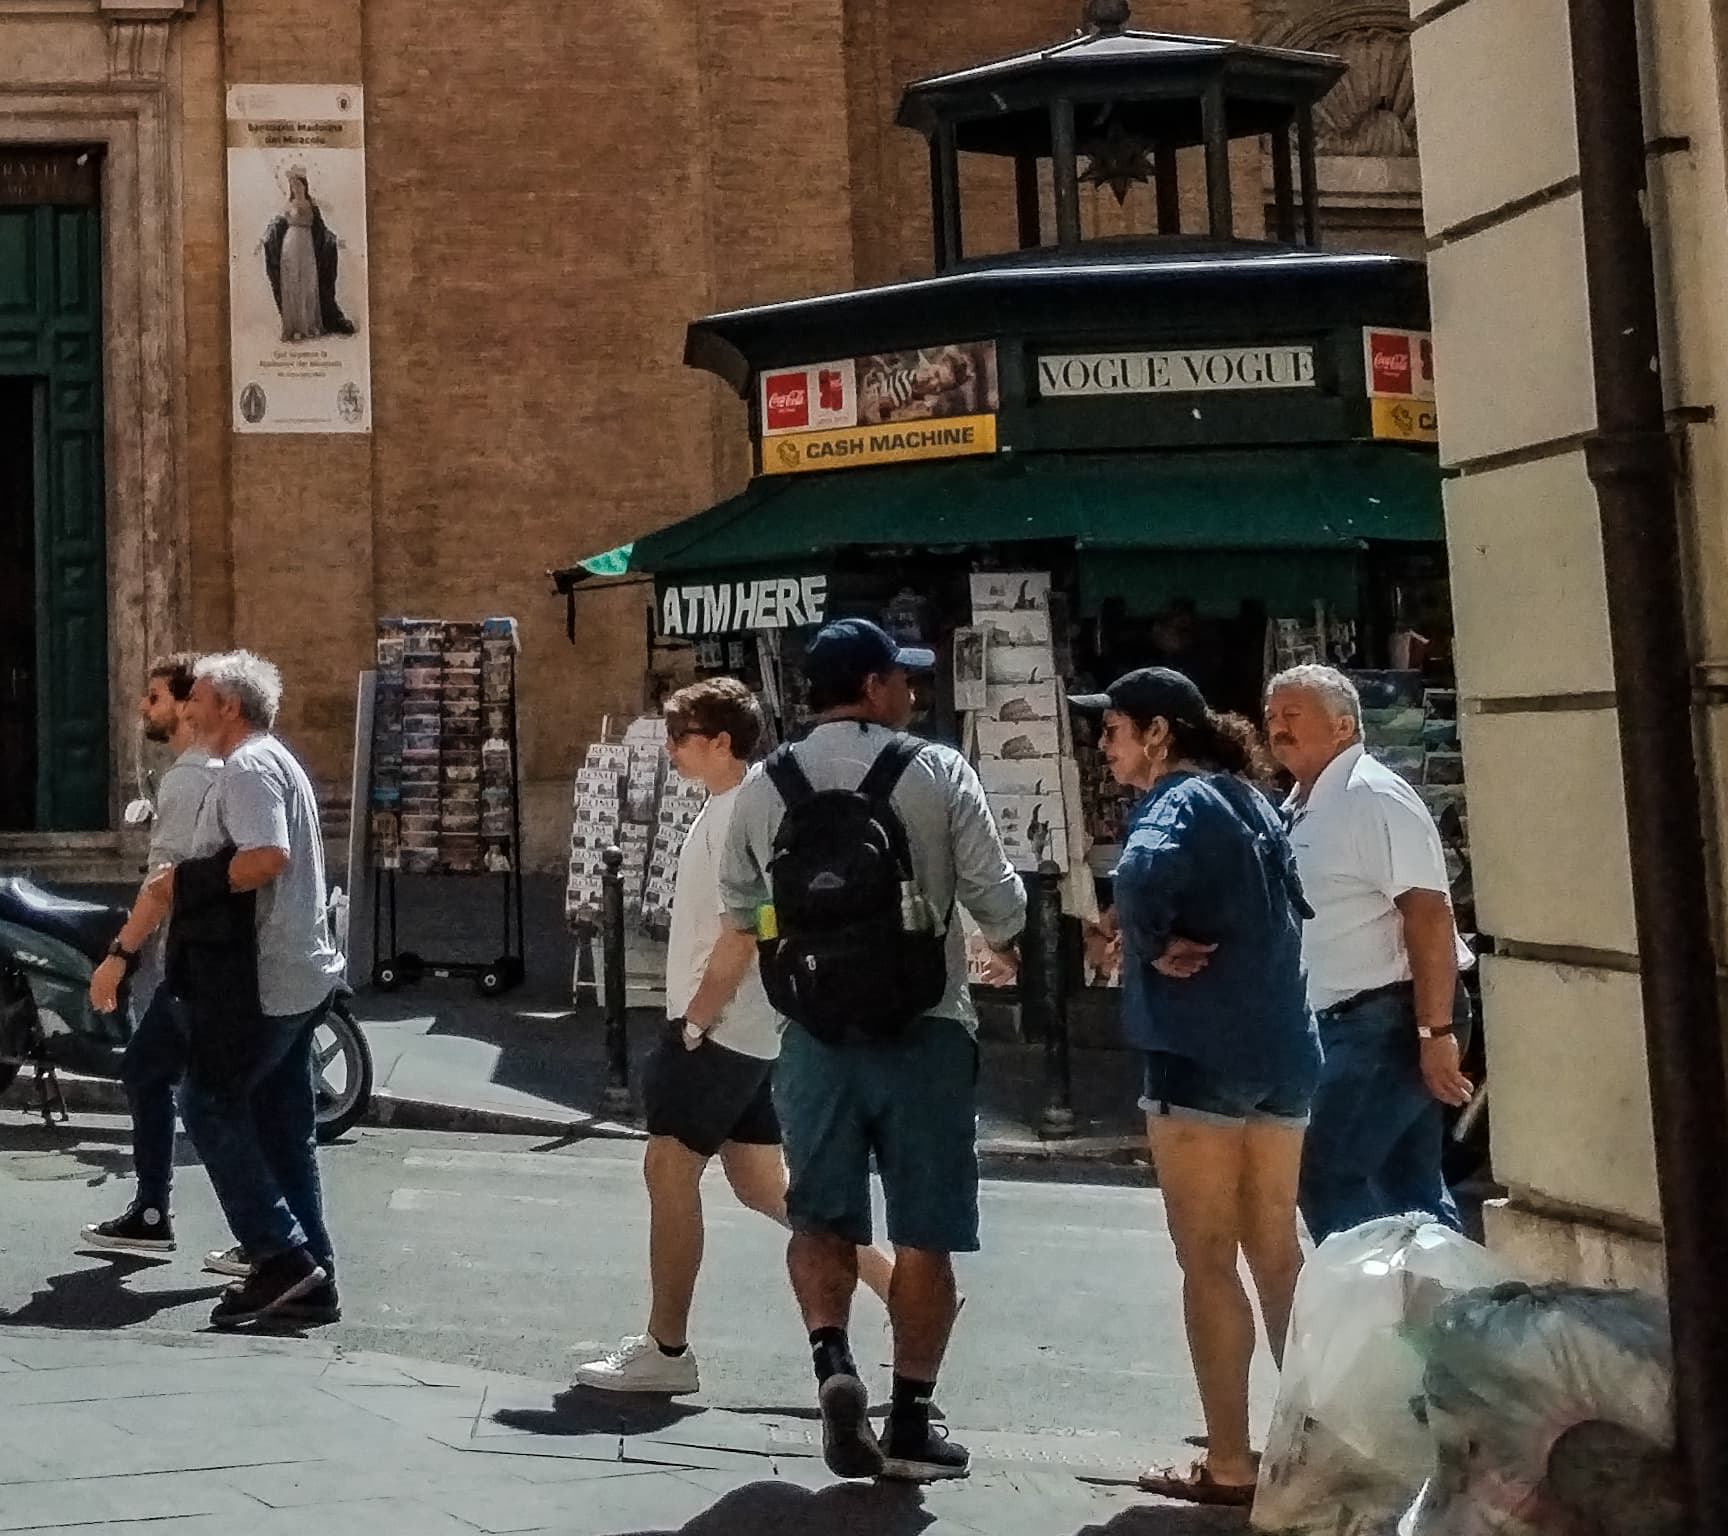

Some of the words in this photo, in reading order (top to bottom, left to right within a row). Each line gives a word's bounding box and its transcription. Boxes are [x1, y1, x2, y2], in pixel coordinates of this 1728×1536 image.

[1041, 355, 1171, 391] VOGUE
[1182, 350, 1314, 386] VOGUE
[806, 437, 865, 460] CASH
[869, 426, 976, 453] MACHINE
[662, 583, 732, 635] ATM
[732, 575, 828, 631] HERE
